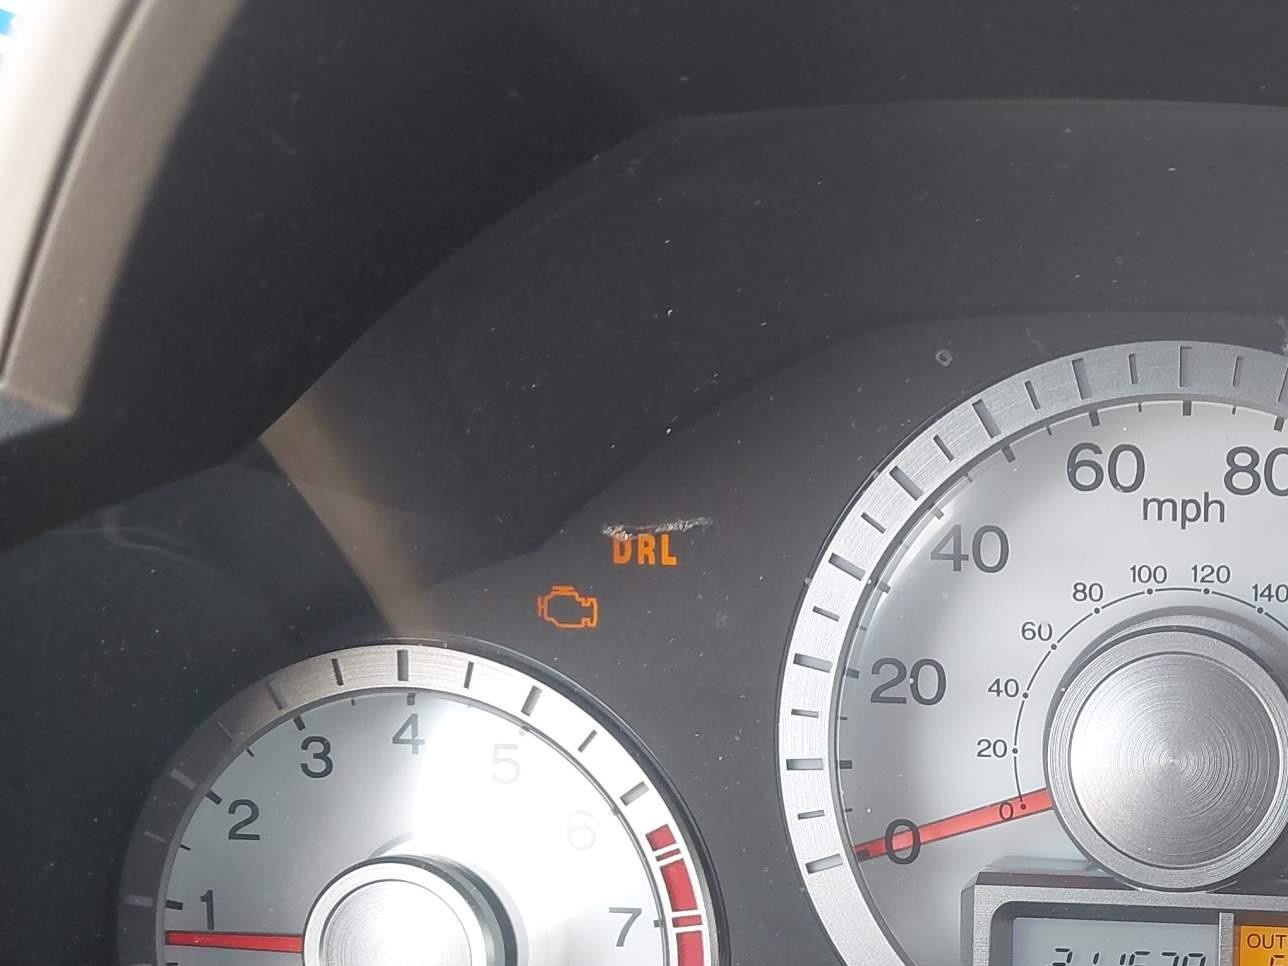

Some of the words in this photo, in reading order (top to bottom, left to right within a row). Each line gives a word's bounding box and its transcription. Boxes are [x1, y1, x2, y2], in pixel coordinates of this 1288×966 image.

[1066, 442, 1145, 493] 60
[1143, 492, 1225, 529] mph
[611, 532, 678, 566] DRL
[931, 524, 1009, 574] 40
[1072, 582, 1104, 602] 80
[1130, 565, 1167, 585] 100
[1191, 564, 1231, 585] 120
[1021, 621, 1053, 642] 60
[870, 657, 946, 705] 20
[988, 678, 1019, 698] 40
[391, 713, 426, 756] 4
[976, 738, 1008, 758] 20
[300, 735, 334, 779] 3
[490, 743, 521, 785] 5
[227, 799, 261, 841] 2
[566, 809, 597, 851] 6
[999, 802, 1014, 821] 0
[885, 818, 921, 865] 0
[199, 889, 216, 930] 1
[608, 906, 643, 948] 7
